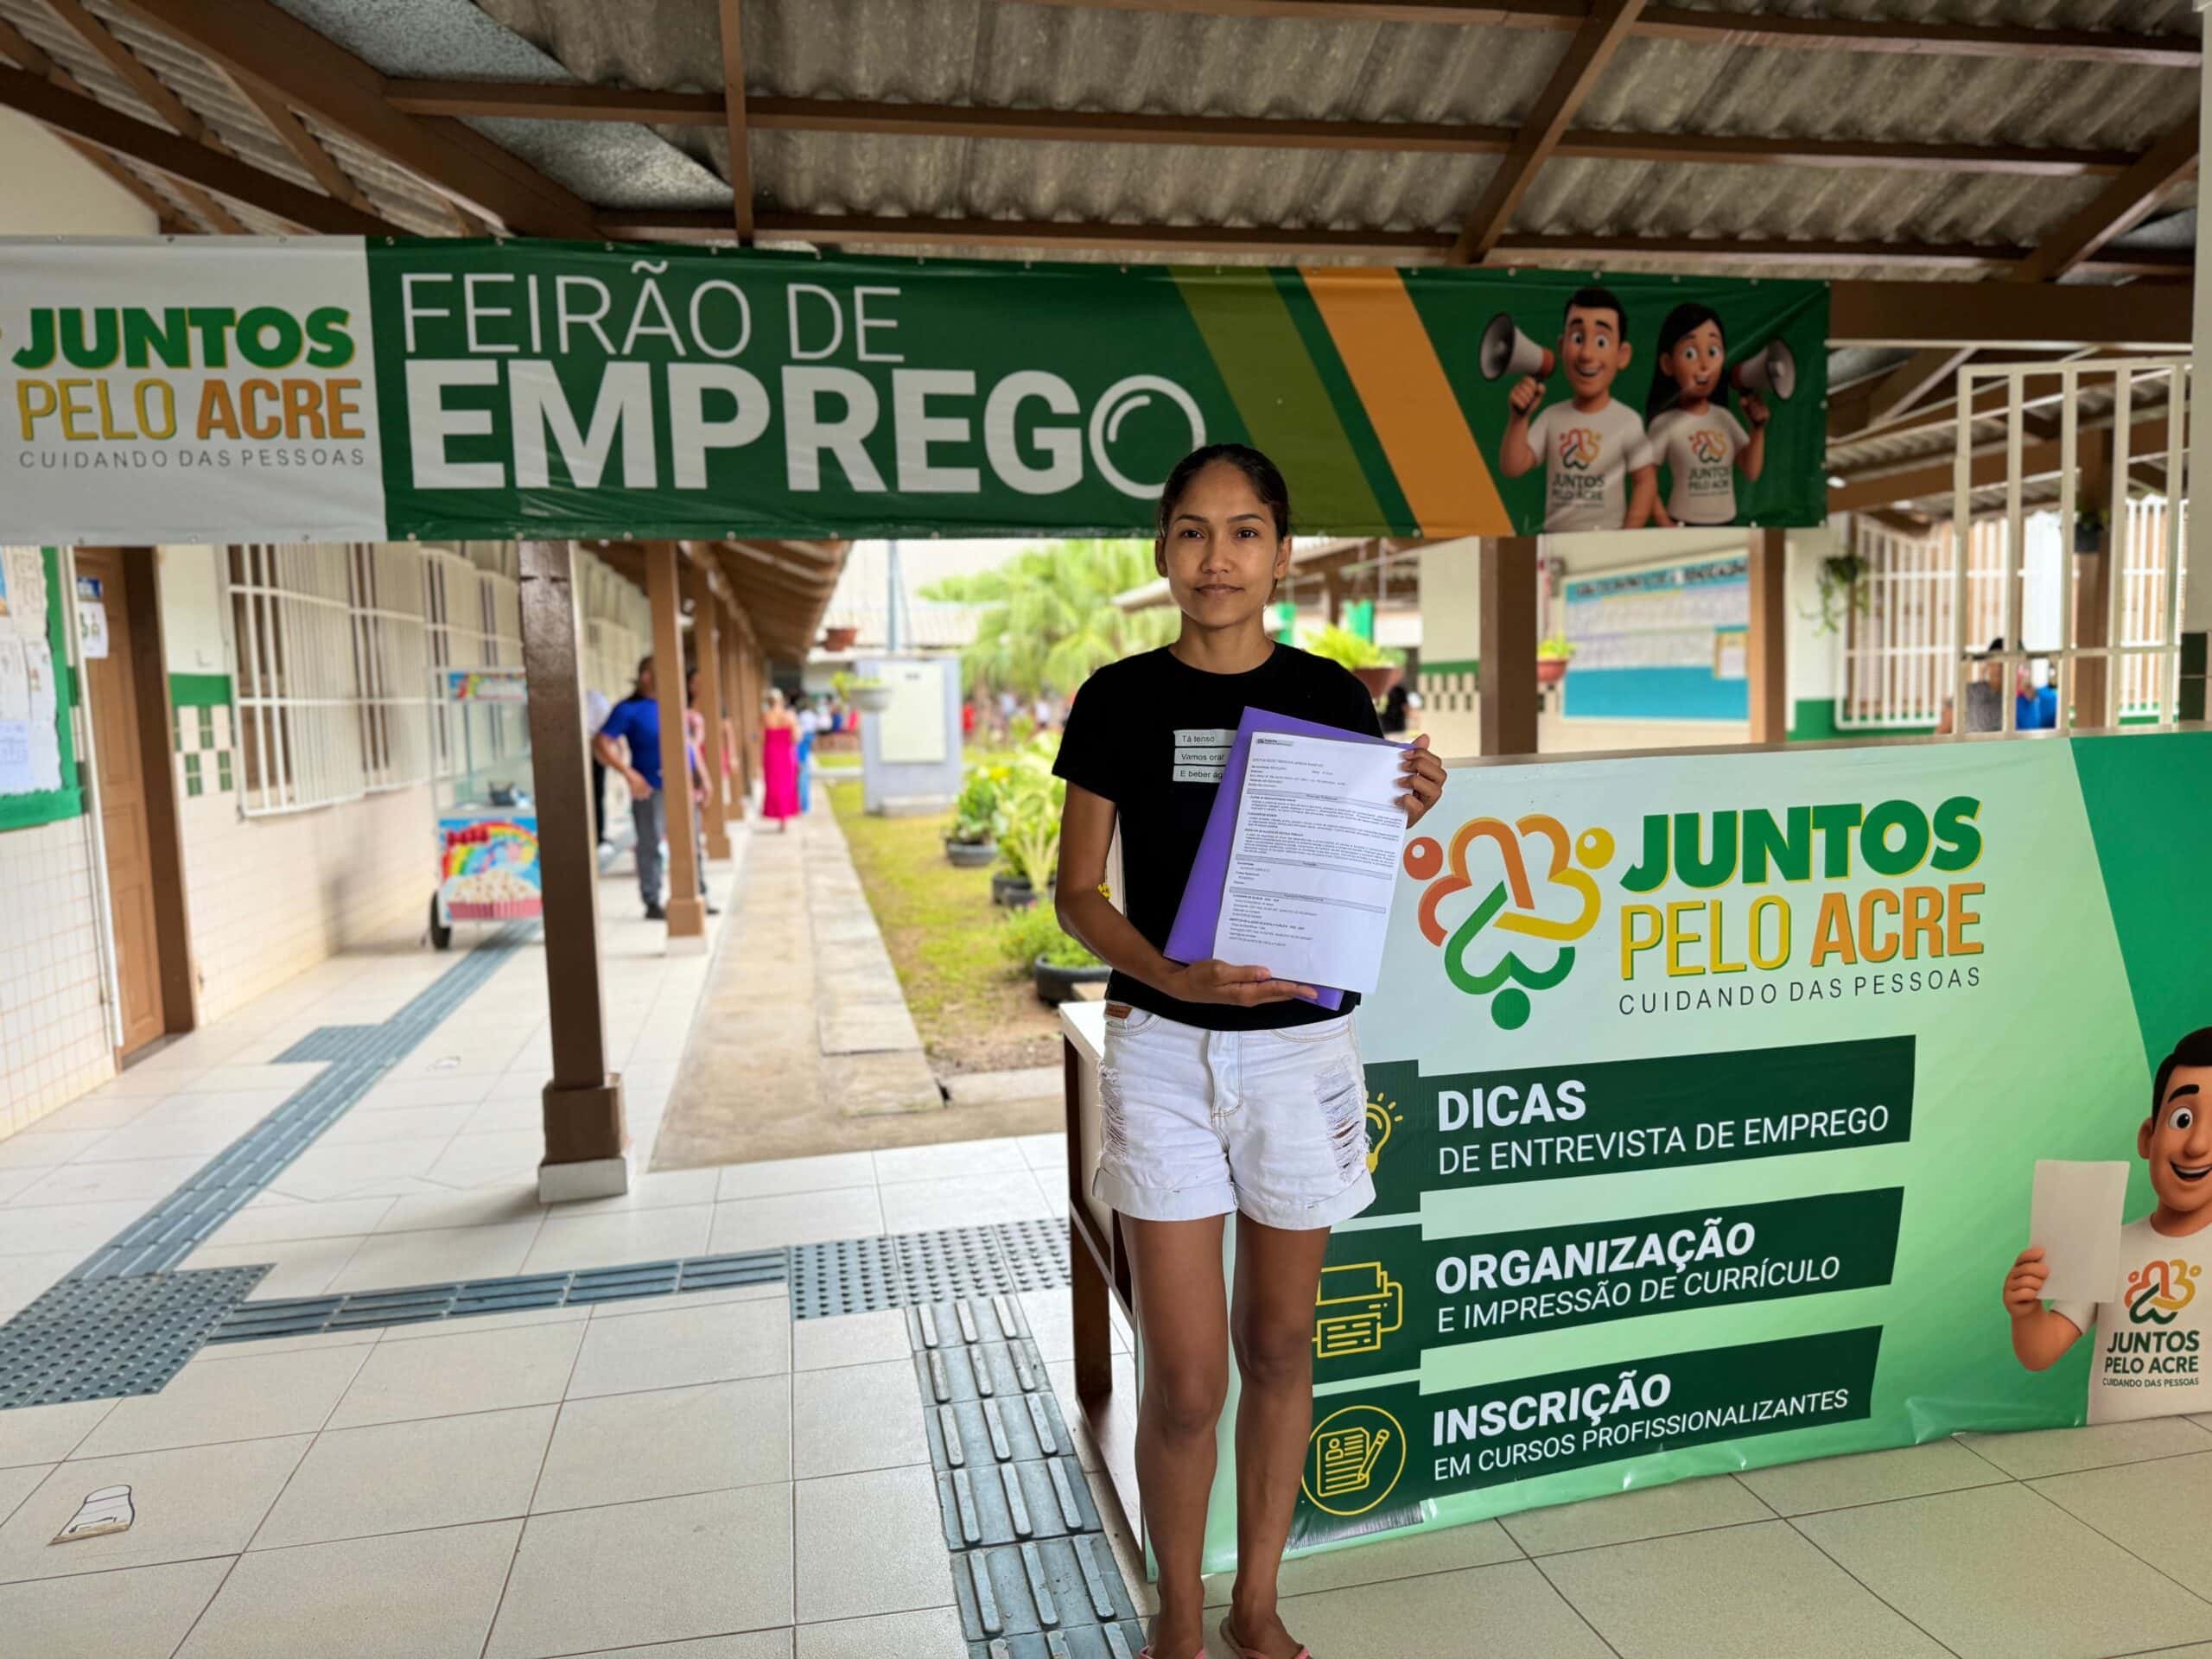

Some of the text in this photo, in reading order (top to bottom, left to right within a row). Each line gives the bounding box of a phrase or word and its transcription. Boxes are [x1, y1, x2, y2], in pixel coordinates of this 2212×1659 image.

[11, 306, 356, 371] JUNTOS
[402, 261, 906, 364] FEIRÃO DE
[16, 378, 365, 441] PELO ACRE
[404, 358, 1207, 499] EMPREGO
[19, 448, 365, 468] CUIDANDO DAS PESSOAS
[1181, 753, 1207, 761] Vamos
[1188, 770, 1211, 779] beber
[1620, 796, 1984, 893] JUNTOS
[1620, 882, 1986, 981] PELO ACRE
[1619, 967, 1981, 1016] CUIDANDO DAS PESSOAS
[1437, 1079, 1587, 1132] DICAS
[1439, 1105, 1890, 1176] DE ENTREVISTA DE EMPREGO
[1435, 1217, 1756, 1294] ORGANIZAÇÃO
[1438, 1255, 1840, 1333] E IMPRESSÃO DE CURRÍCULO
[2104, 1355, 2199, 1374] PELO ACRE
[2107, 1330, 2200, 1354] JUNTOS
[1433, 1370, 1672, 1446] INSCRIÇÃO
[2101, 1376, 2199, 1388] CUIDANDO DAS PESSOAS
[1434, 1389, 1849, 1482] EM CURSOS PROFISSIONALIZANTES
